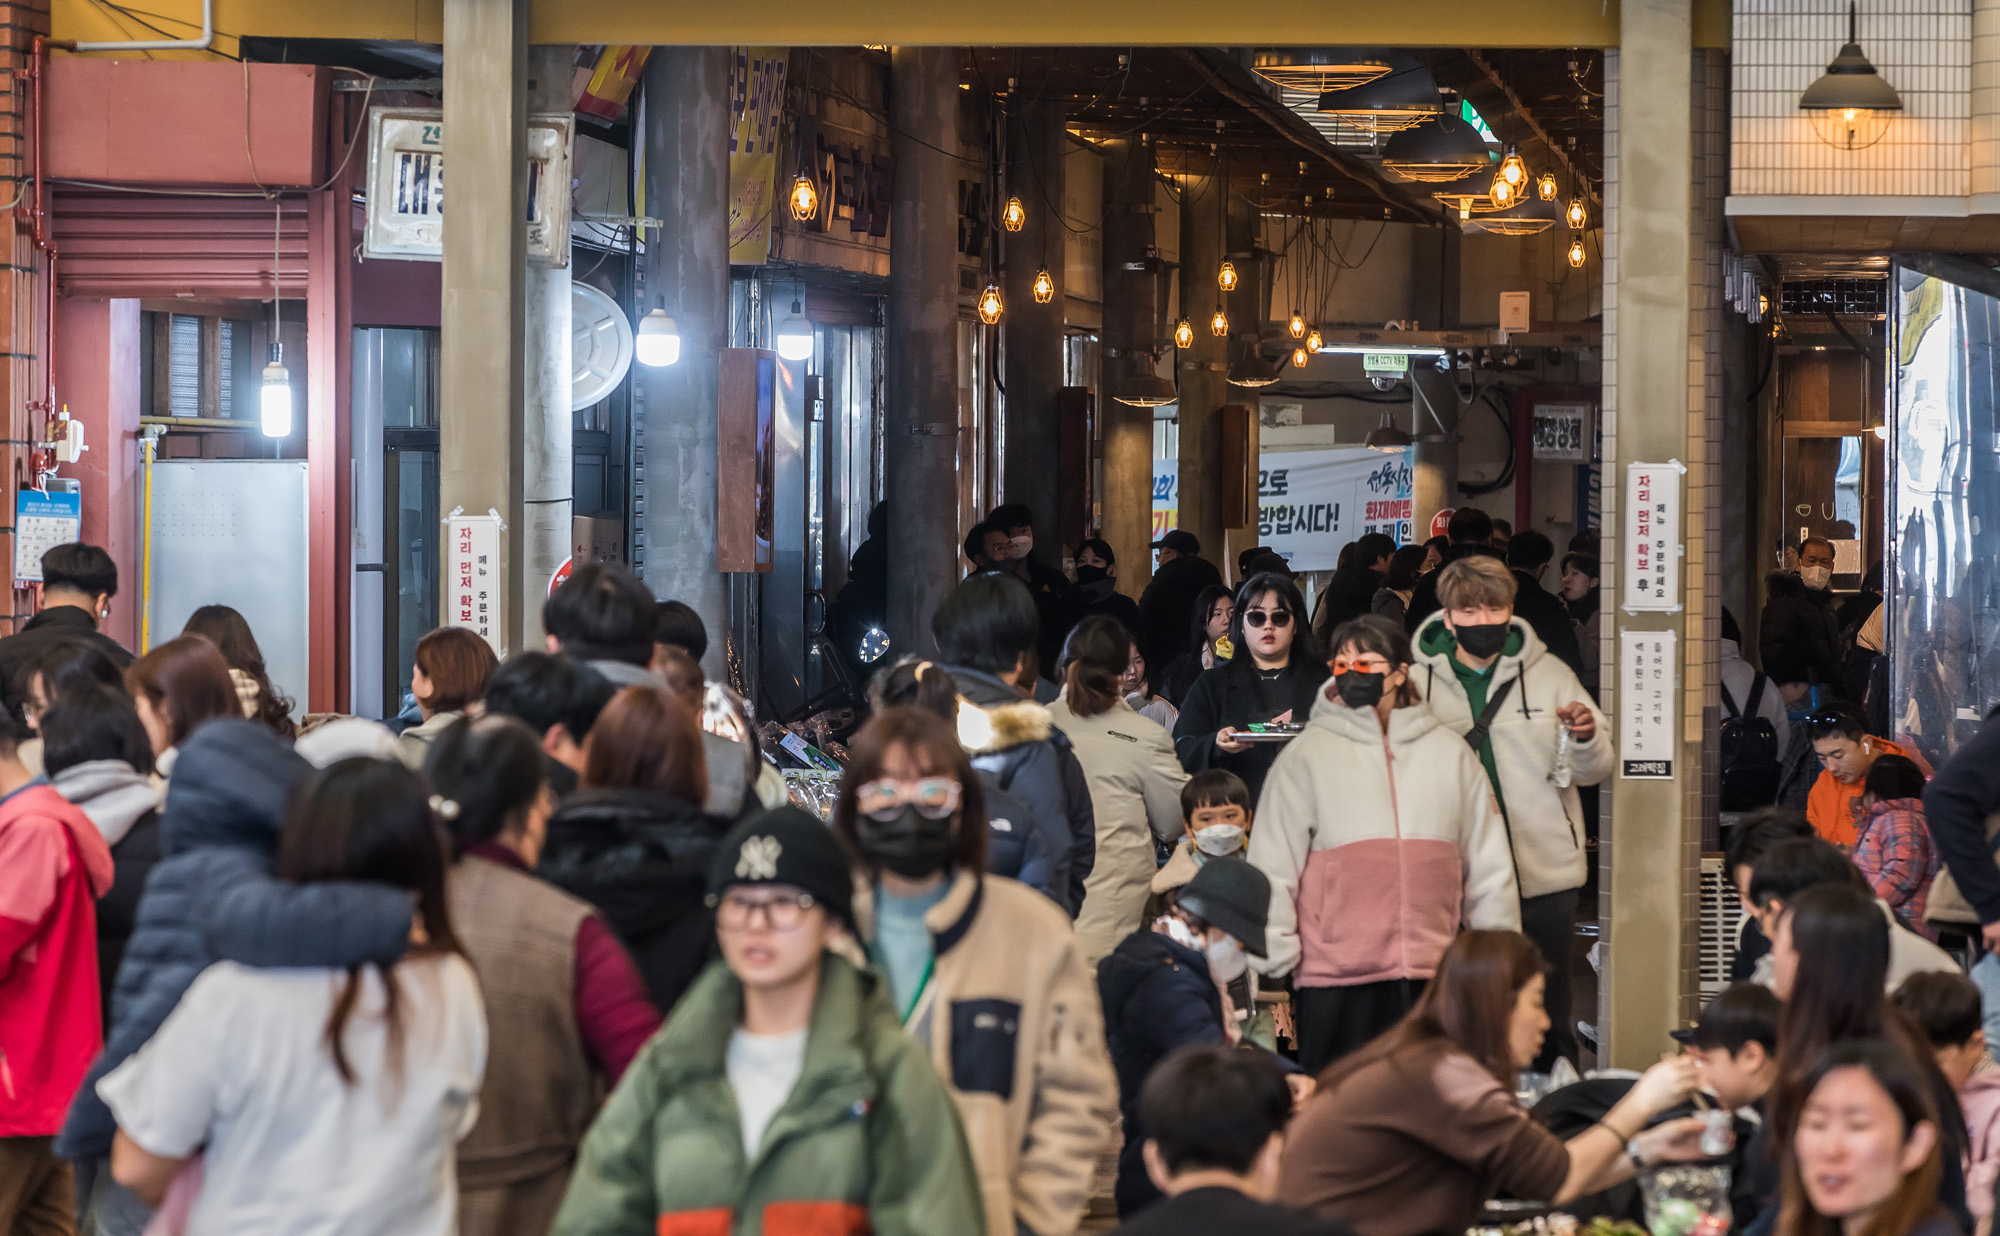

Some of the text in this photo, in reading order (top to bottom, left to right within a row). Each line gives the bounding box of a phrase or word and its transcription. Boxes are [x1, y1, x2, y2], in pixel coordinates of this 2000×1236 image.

[460, 527, 472, 622] 자리 먼저 확보
[1637, 475, 1650, 592] 자리 먼저 확보 후
[1655, 504, 1666, 598] 메뉴 주문하세요
[478, 555, 488, 637] 메뉴 주문하세
